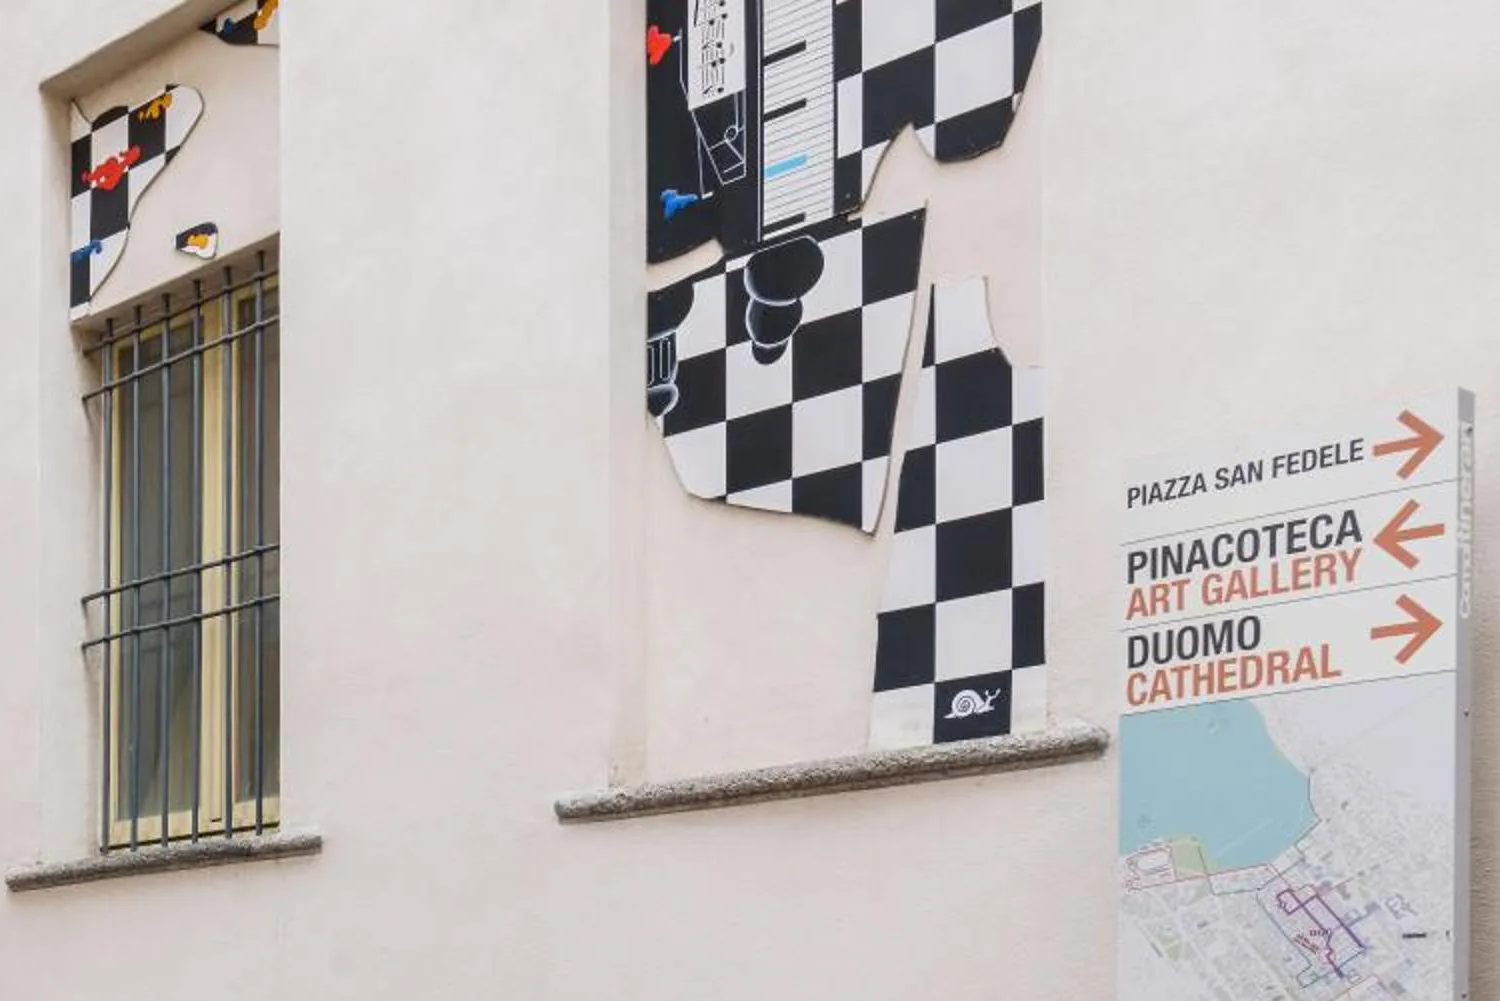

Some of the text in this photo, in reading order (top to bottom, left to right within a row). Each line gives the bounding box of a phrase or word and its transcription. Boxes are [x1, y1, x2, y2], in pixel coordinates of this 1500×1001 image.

[1127, 438, 1364, 508] PIAZZA SAN FEDELE
[1127, 509, 1363, 585] PINACOTECA
[1125, 547, 1363, 620] ART GALLERY
[1126, 643, 1343, 707] CATHEDRAL
[1127, 615, 1261, 669] DUOMO
